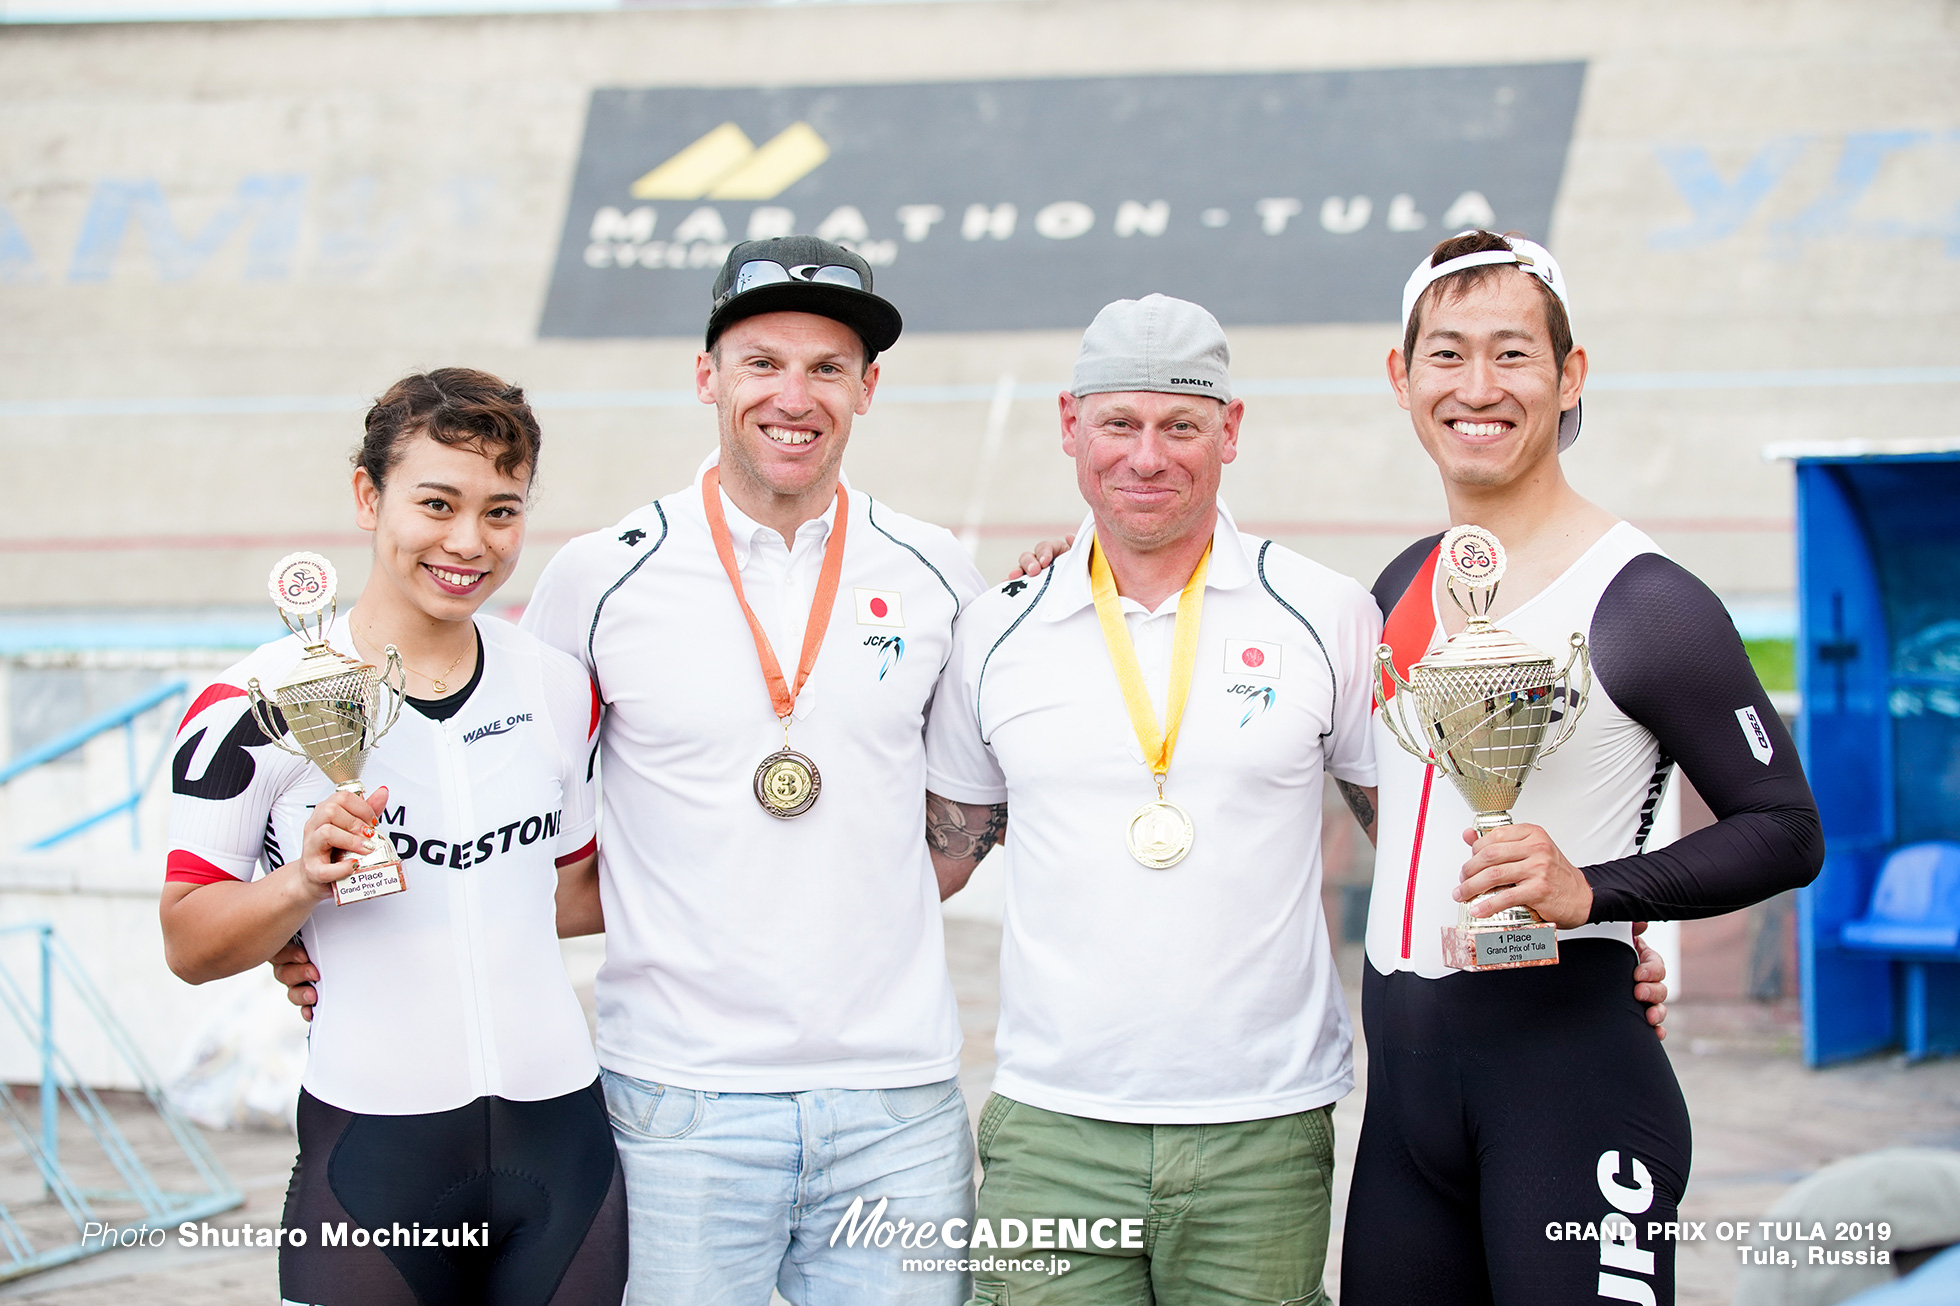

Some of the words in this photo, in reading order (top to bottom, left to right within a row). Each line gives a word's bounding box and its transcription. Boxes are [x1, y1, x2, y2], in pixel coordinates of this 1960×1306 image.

[589, 199, 1171, 243] MARATHON
[1256, 190, 1497, 236] TULA
[1170, 378, 1214, 388] OAKLEY
[863, 635, 887, 647] JCF
[1226, 683, 1256, 695] JCF
[463, 720, 502, 743] WAVE
[506, 713, 533, 726] ONE
[777, 774, 798, 796] 3
[389, 808, 562, 870] DGESTON
[358, 872, 383, 882] Place
[340, 886, 360, 894] Grand
[1499, 935, 1504, 944] 1
[1507, 934, 1531, 942] Place
[1487, 946, 1507, 954] Grand
